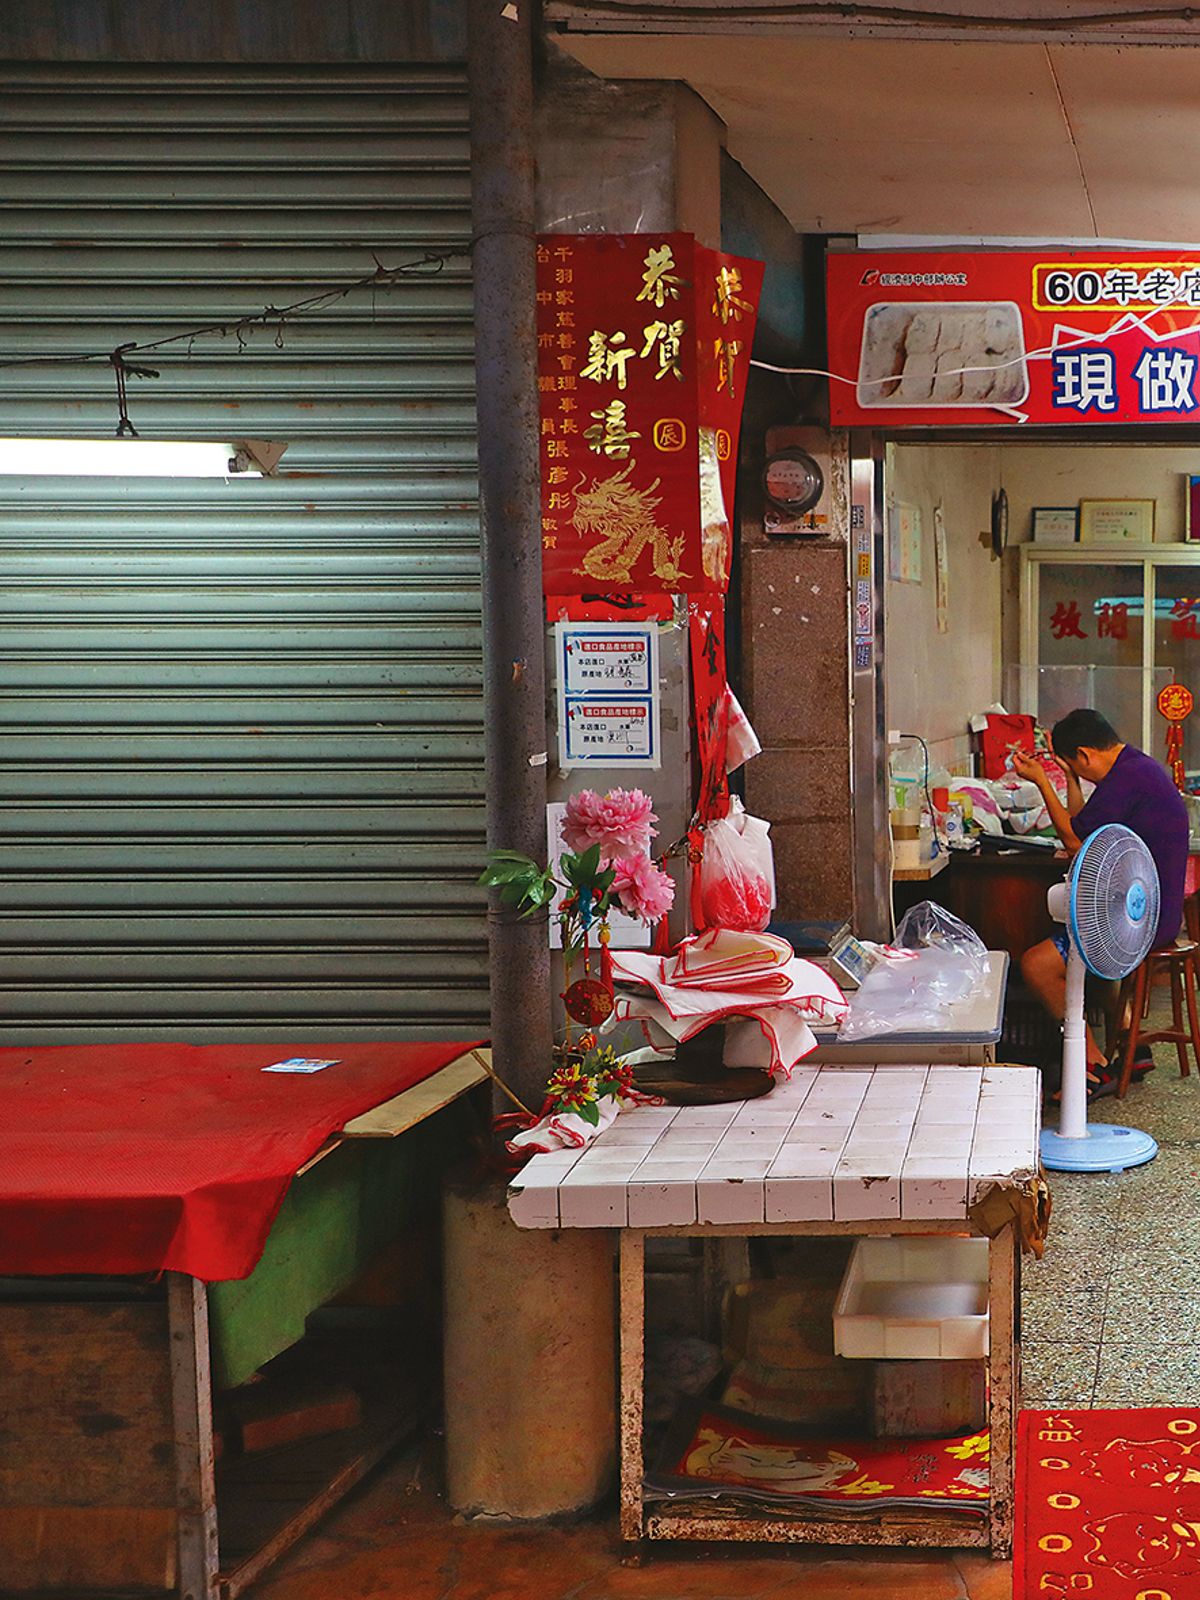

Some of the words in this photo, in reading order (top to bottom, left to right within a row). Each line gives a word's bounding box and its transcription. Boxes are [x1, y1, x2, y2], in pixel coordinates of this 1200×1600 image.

[536, 244, 557, 436] 台中市議員
[636, 244, 692, 382] 恭賀
[579, 329, 642, 461] 新禧
[659, 424, 682, 448] 辰
[1055, 350, 1196, 412] 現做
